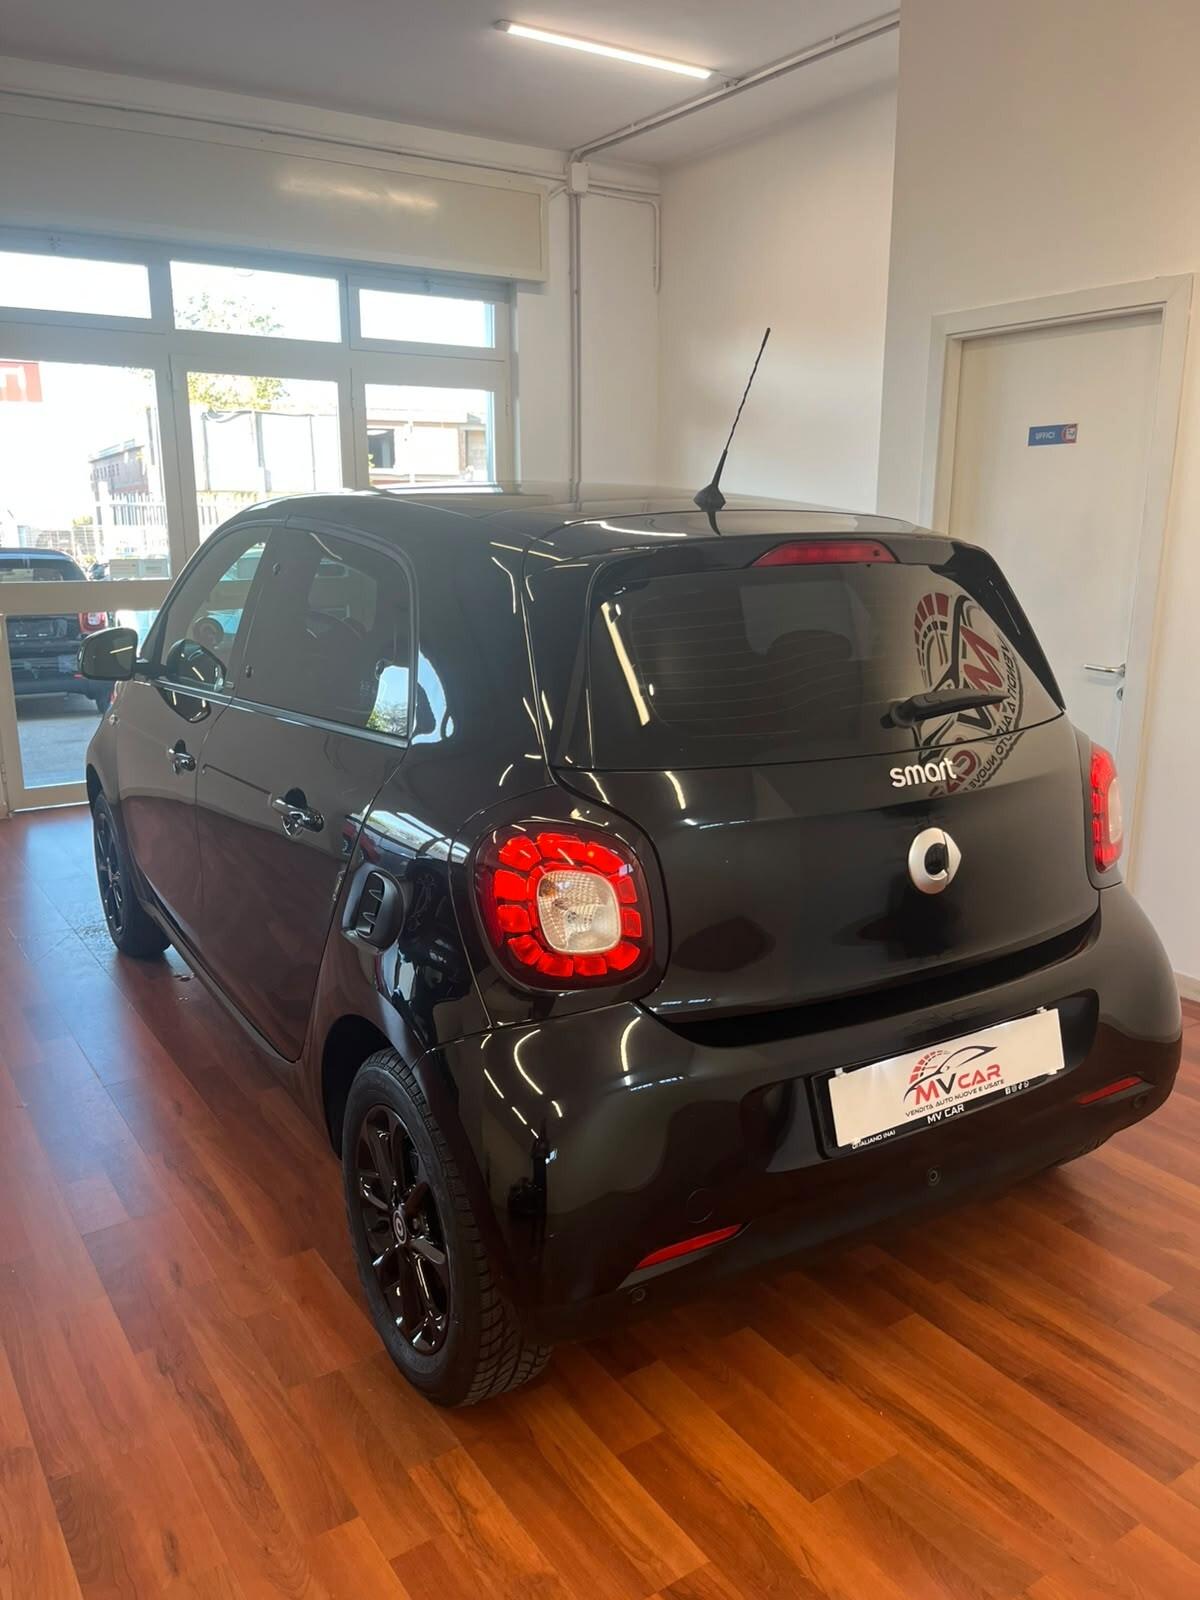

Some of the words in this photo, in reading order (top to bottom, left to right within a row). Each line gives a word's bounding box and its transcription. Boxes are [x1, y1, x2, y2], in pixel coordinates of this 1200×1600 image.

[889, 757, 957, 788] smart
[905, 1104, 934, 1118] VENDITA
[935, 1096, 954, 1107] AUTO
[954, 1089, 978, 1101] NUOVE
[983, 1079, 1005, 1091] USATE
[927, 1112, 943, 1125] MV
[944, 1103, 965, 1118] CAR
